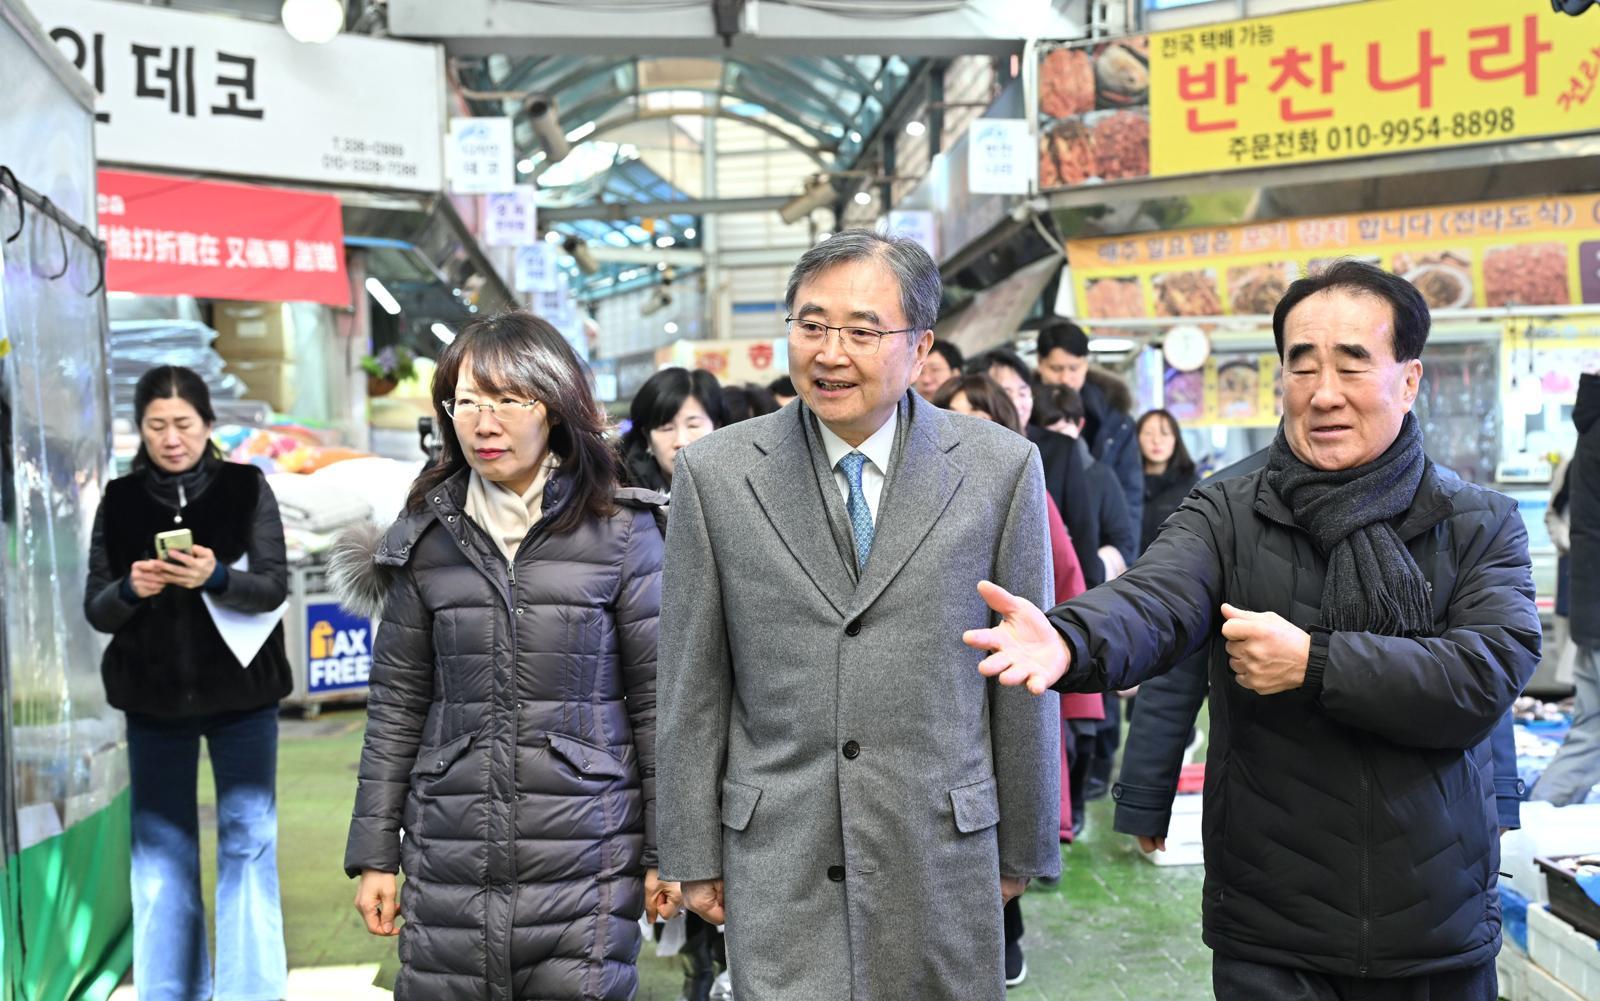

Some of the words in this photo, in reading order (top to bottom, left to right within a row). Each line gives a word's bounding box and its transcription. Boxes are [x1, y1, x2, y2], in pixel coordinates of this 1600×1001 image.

[1162, 33, 1195, 59] 전국
[1200, 26, 1235, 51] 택배
[1239, 22, 1275, 46] 가능
[1228, 128, 1319, 163] 주문전화
[1326, 107, 1516, 151] 010-9954-8898
[1098, 240, 1139, 261] 매주
[1147, 230, 1232, 259] 일요일은
[1358, 211, 1432, 241] 합니다
[1440, 200, 1574, 235] (전라도식)
[310, 654, 371, 687] FREE
